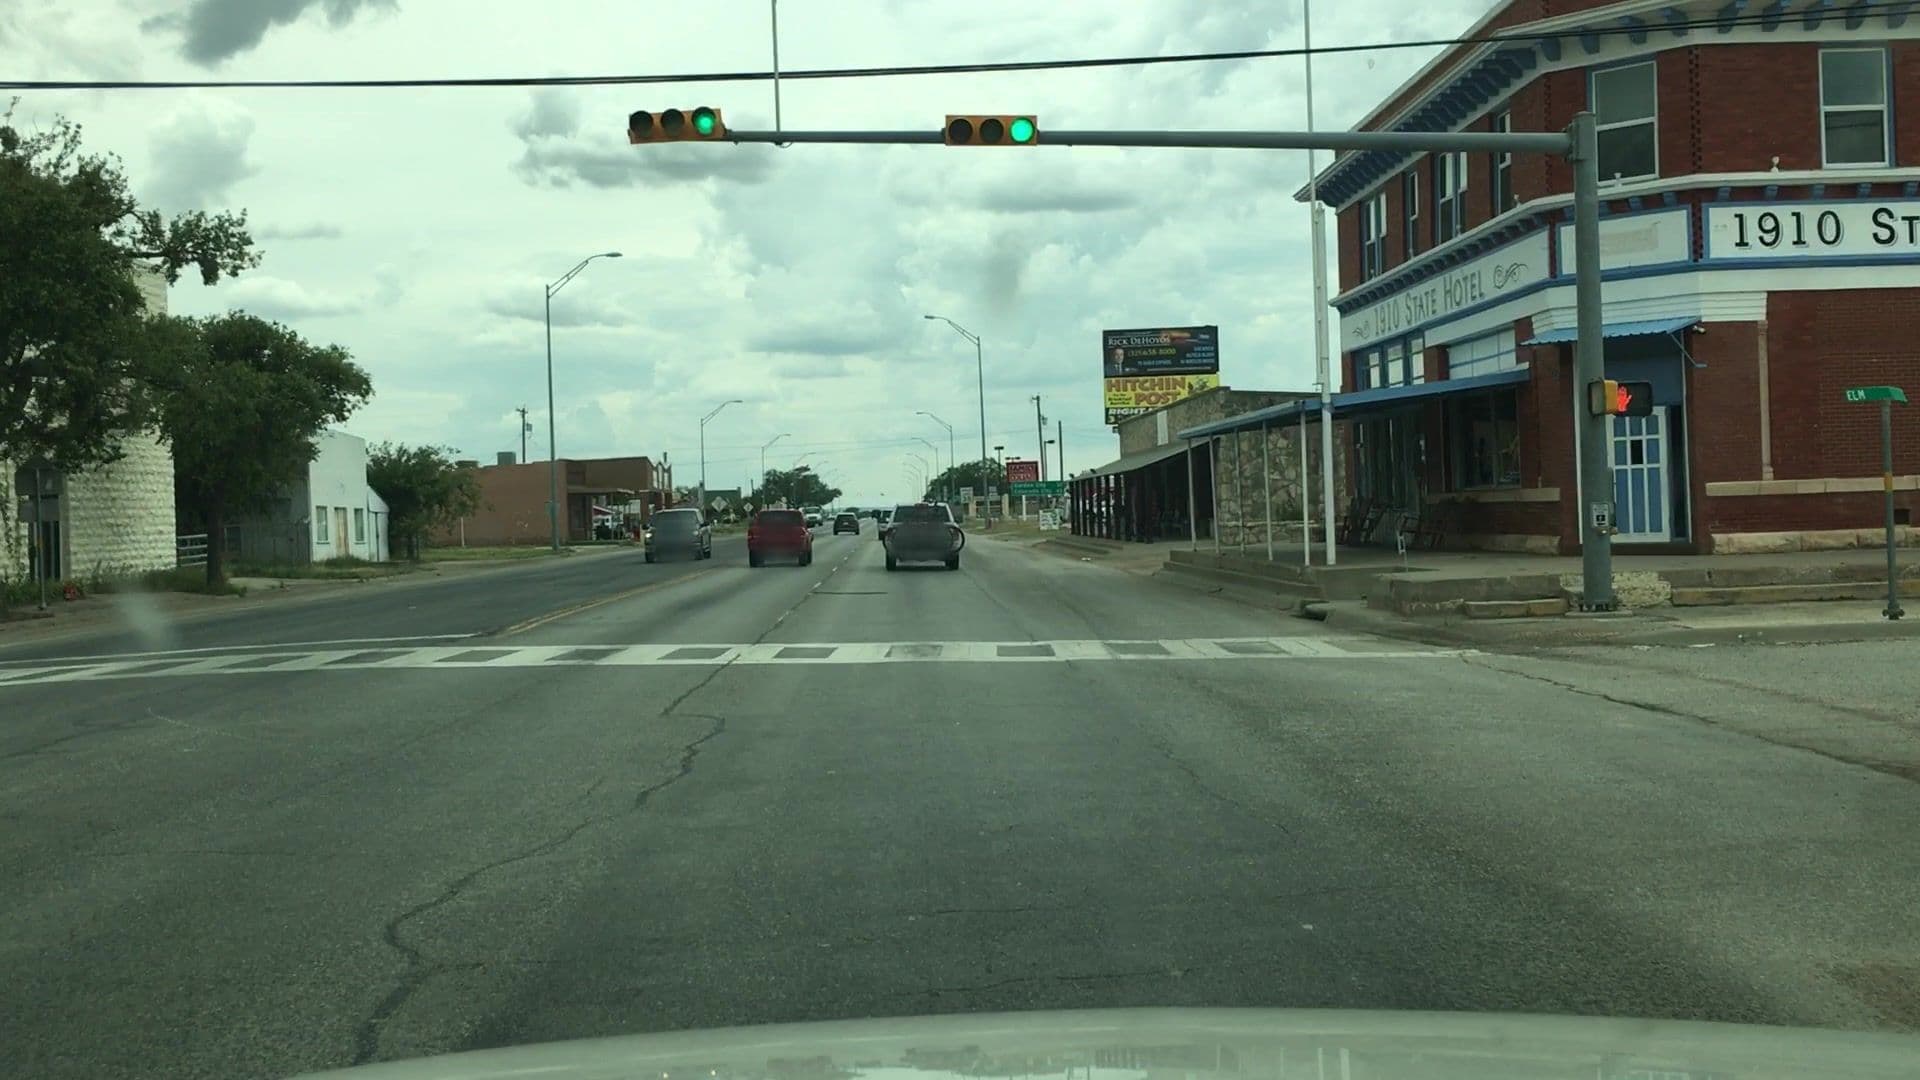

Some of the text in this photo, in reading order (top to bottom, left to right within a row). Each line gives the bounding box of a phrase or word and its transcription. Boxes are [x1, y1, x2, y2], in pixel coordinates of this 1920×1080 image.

[1734, 211, 1844, 247] 1910
[1374, 305, 1400, 336] 1910
[1135, 392, 1181, 406] POST
[1844, 390, 1866, 401] ELM
